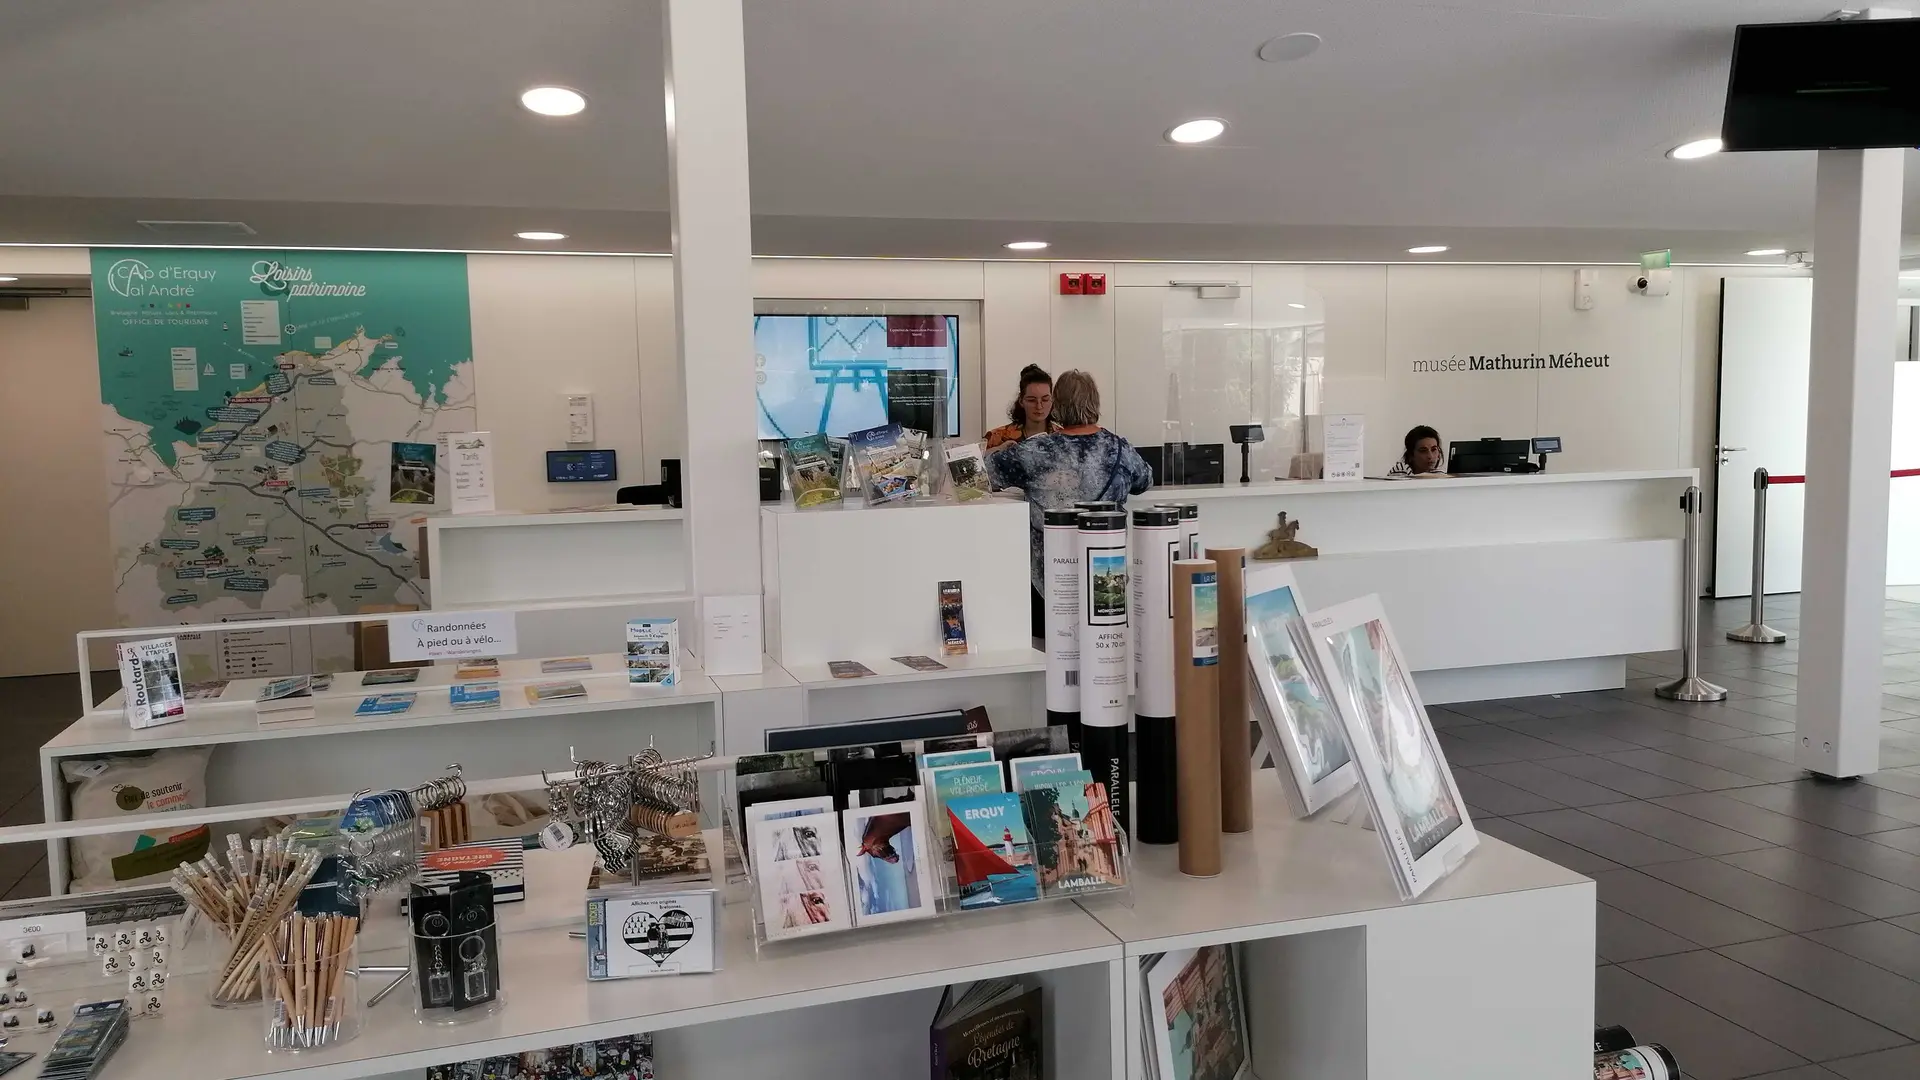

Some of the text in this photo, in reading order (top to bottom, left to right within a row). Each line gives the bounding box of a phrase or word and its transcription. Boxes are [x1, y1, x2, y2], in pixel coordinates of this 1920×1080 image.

[159, 266, 216, 281] d'Erquy
[250, 261, 312, 290] Loisirs
[149, 285, 194, 296] André
[287, 281, 366, 302] patrimoine
[122, 318, 151, 326] OFFICE
[1413, 352, 1610, 373] musée Mathurin Méheut
[427, 622, 487, 633] Randonnées
[417, 635, 502, 649] À pied ou à vélo...
[1098, 632, 1123, 640] AFFICHE
[141, 641, 172, 651] VILLAGES
[129, 658, 146, 706] Routard
[152, 782, 182, 797] soutenir
[964, 805, 1005, 820] ERQUY
[436, 853, 493, 862] BRETAGNE
[1058, 876, 1106, 889] LAMBALLE
[968, 1036, 1020, 1068] Bretagne
